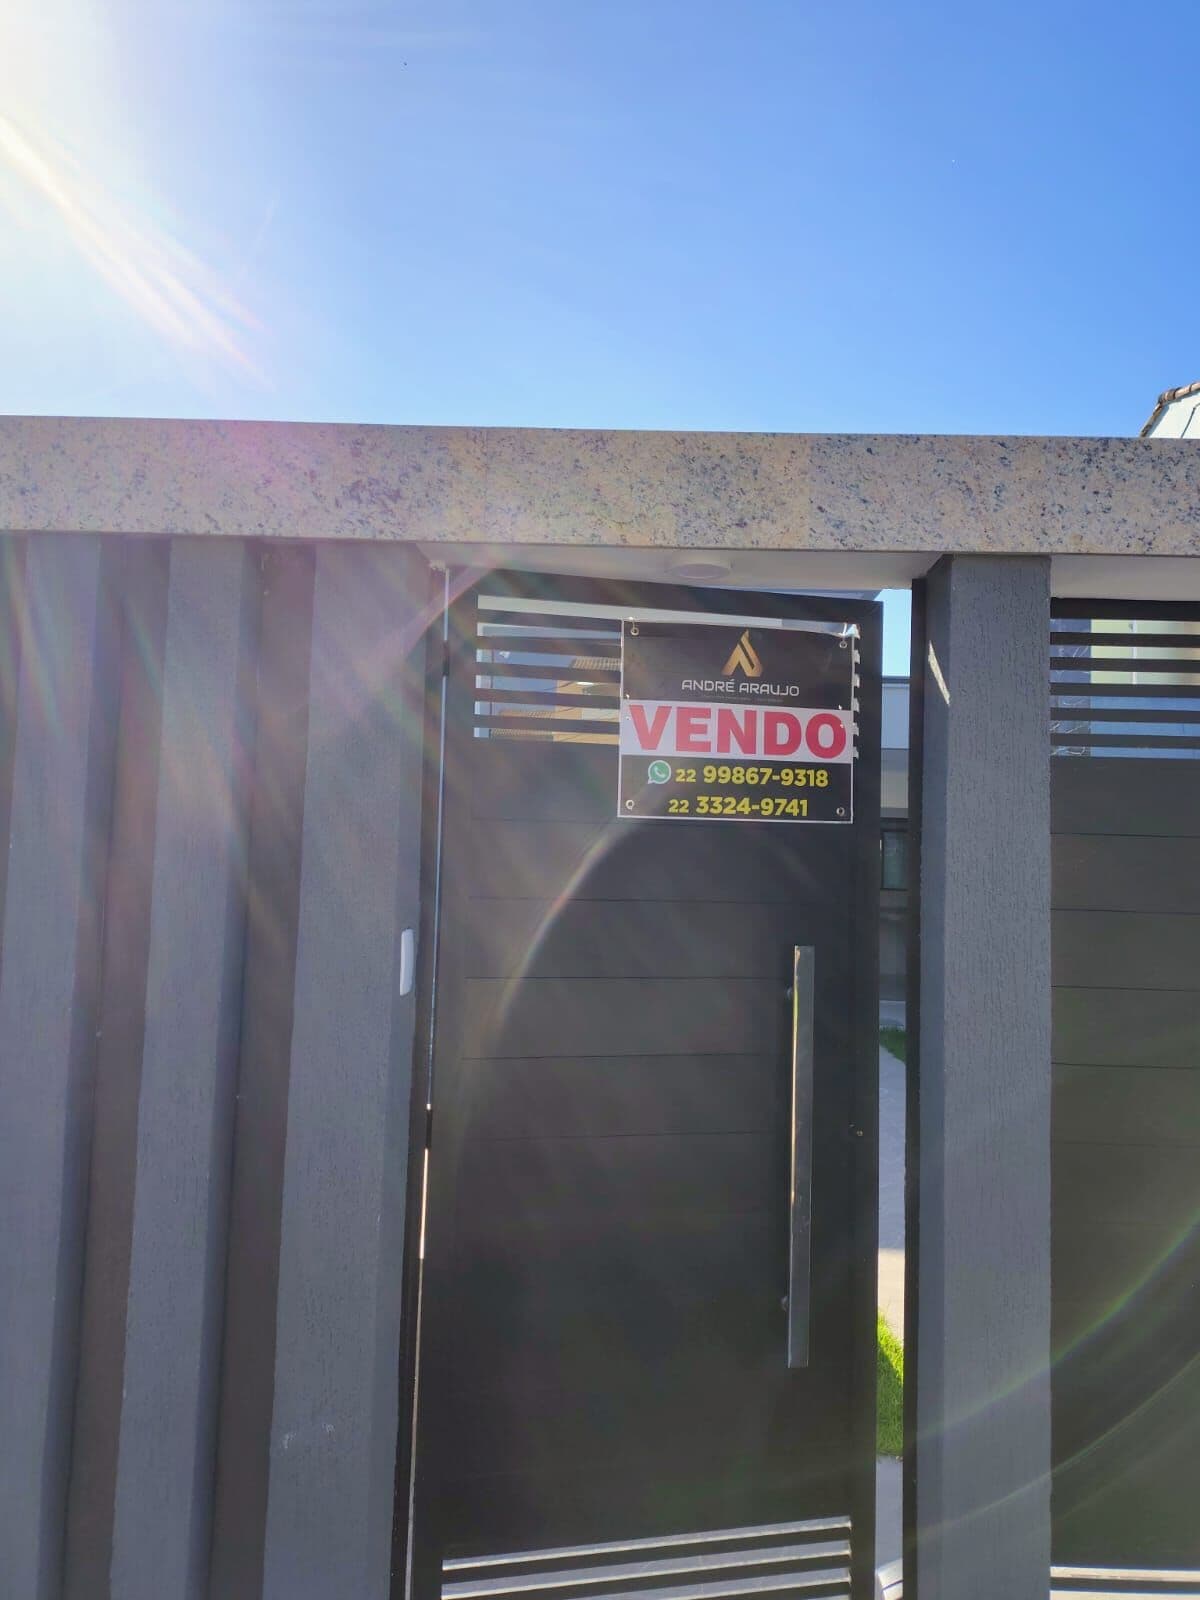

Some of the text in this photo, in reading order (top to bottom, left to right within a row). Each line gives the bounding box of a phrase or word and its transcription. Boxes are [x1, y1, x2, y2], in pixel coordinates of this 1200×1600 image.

[681, 679, 800, 697] ANDRÉ ARAUJO
[629, 704, 847, 759] VENDO
[675, 765, 829, 787] 22 99867-9318
[668, 796, 808, 816] 22 3324-9741
